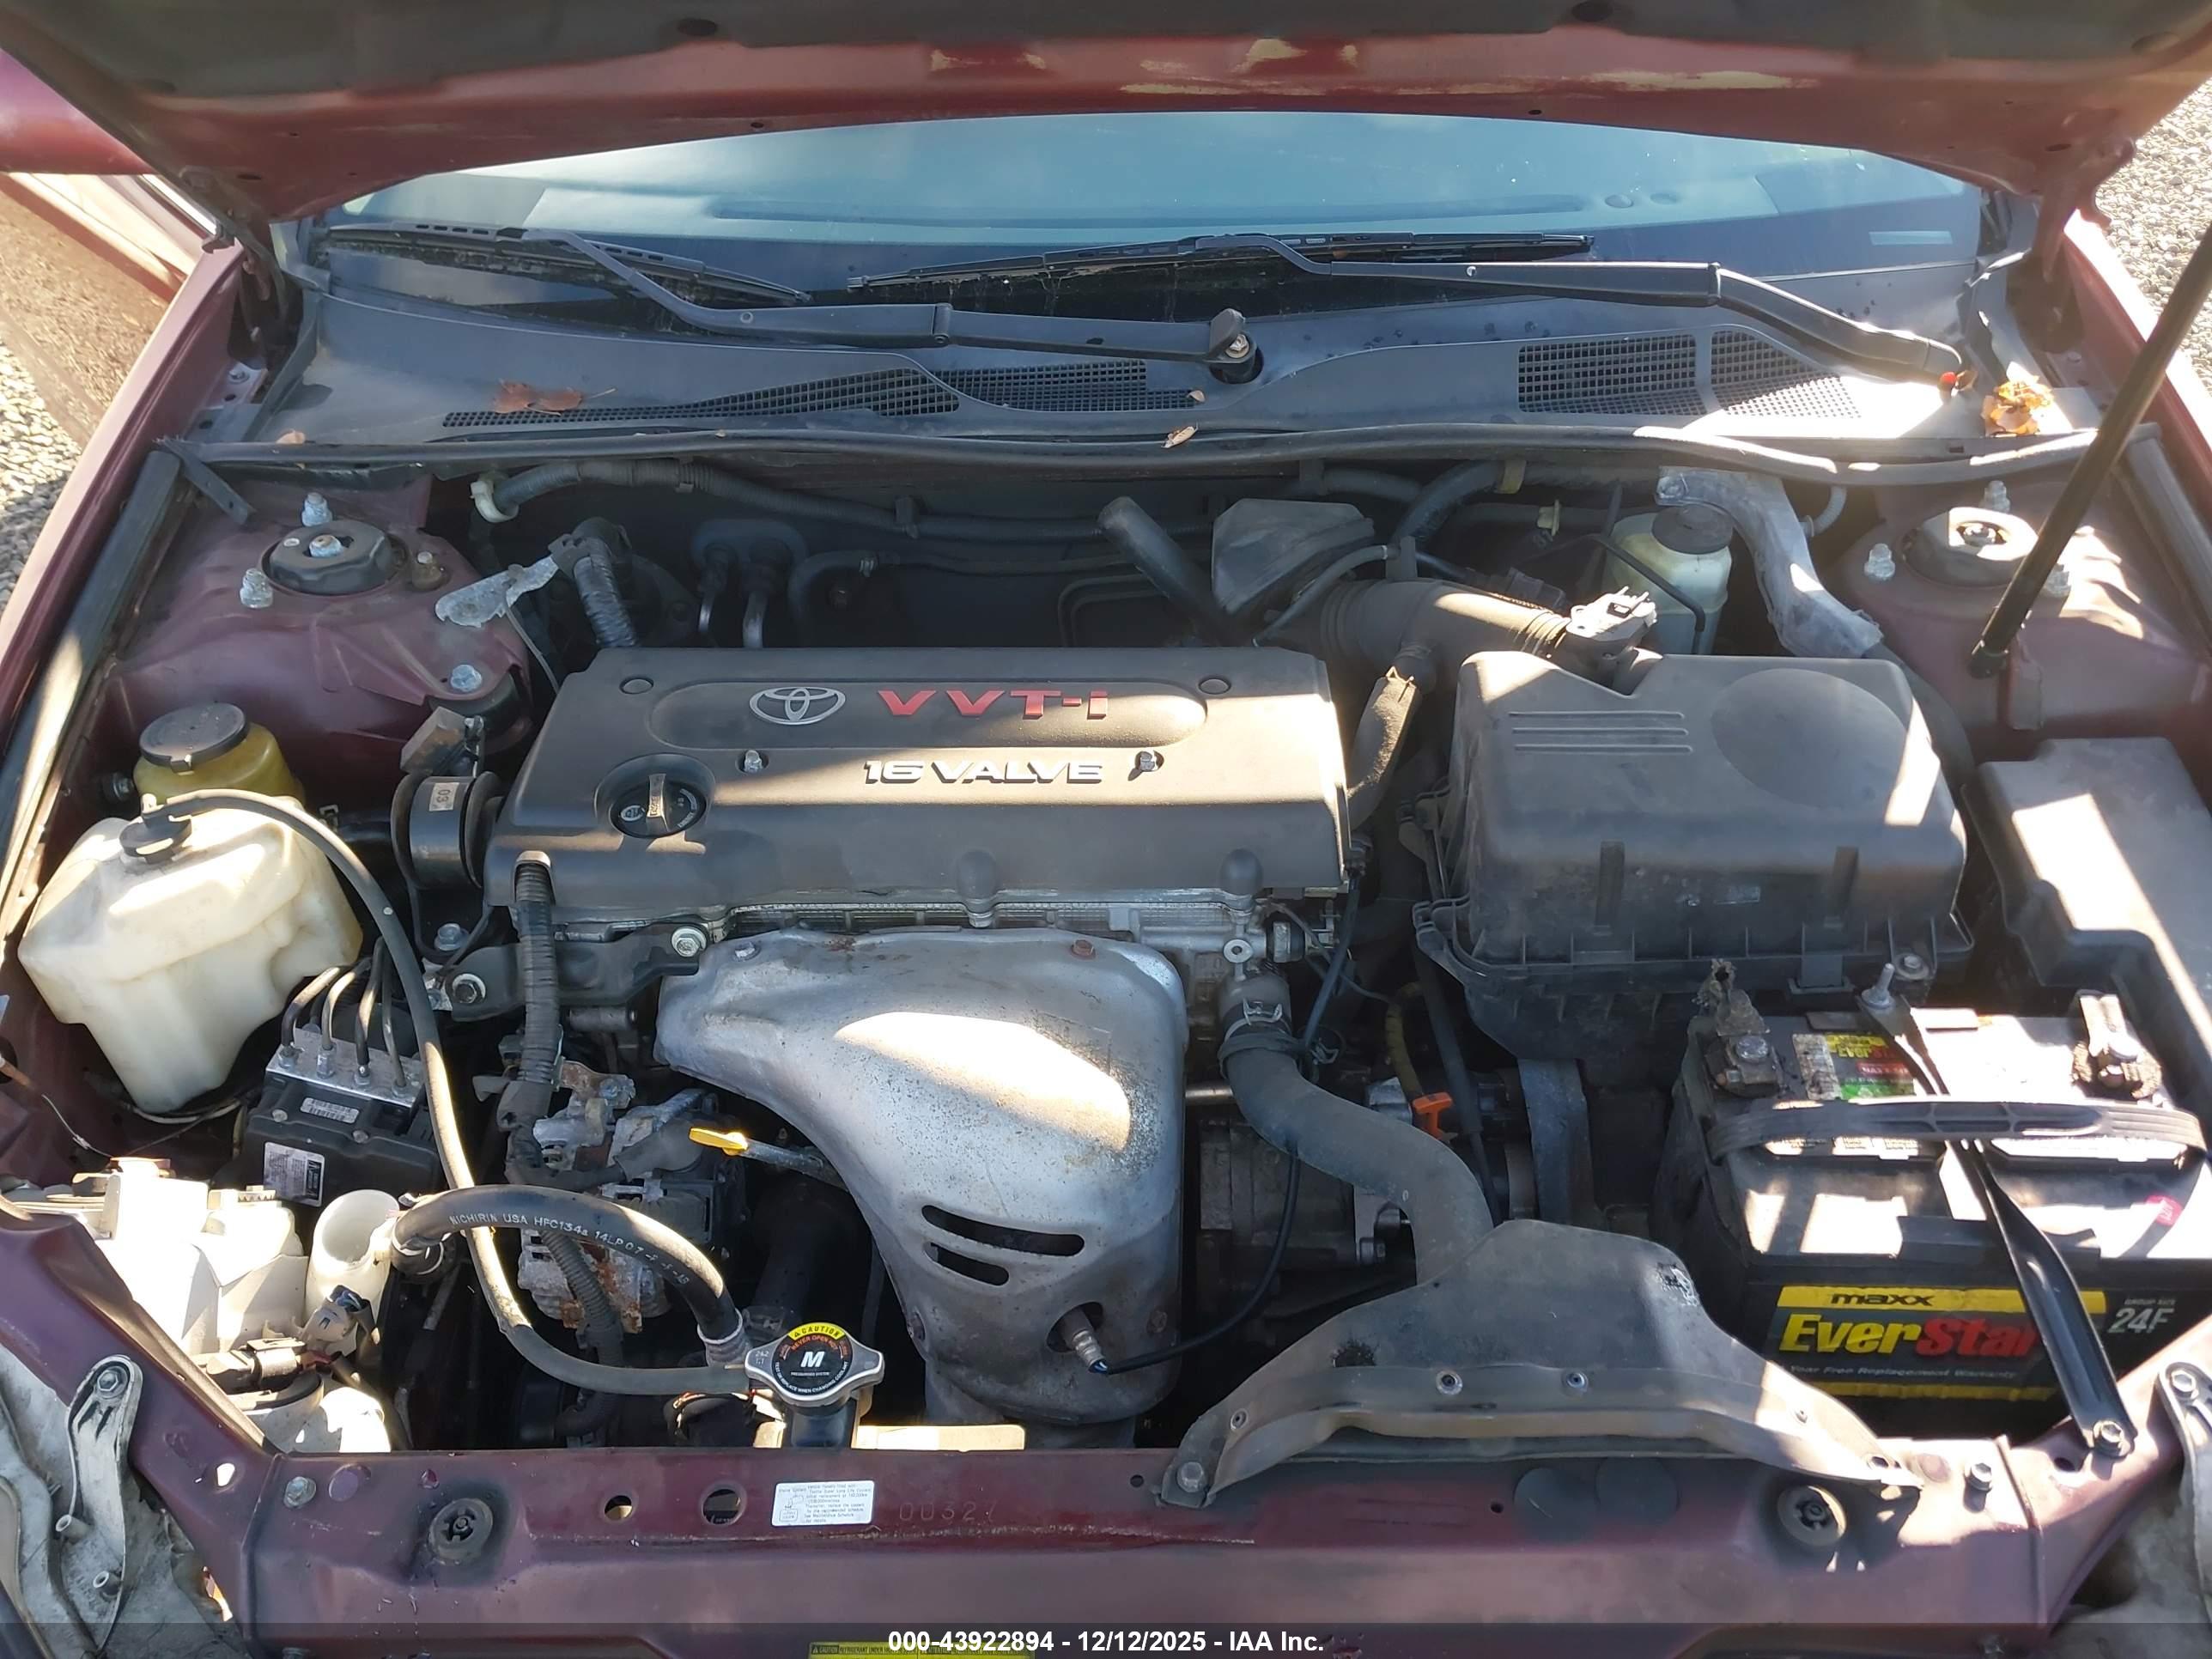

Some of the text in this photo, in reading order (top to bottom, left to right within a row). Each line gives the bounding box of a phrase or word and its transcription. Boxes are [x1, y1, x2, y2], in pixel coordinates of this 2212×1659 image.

[864, 760, 1103, 785] 16 VALVE
[449, 1212, 497, 1225] NICHIRIN
[502, 1213, 529, 1224] USA
[1830, 1292, 1935, 1307] maxx
[2107, 1307, 2175, 1334] 24F
[802, 1324, 840, 1337] CAUTION
[790, 1335, 812, 1351] NEVER
[811, 1334, 829, 1344] OPEN
[799, 1351, 826, 1367] M
[811, 1379, 836, 1393] CHANGING
[836, 1361, 849, 1381] COOLANT
